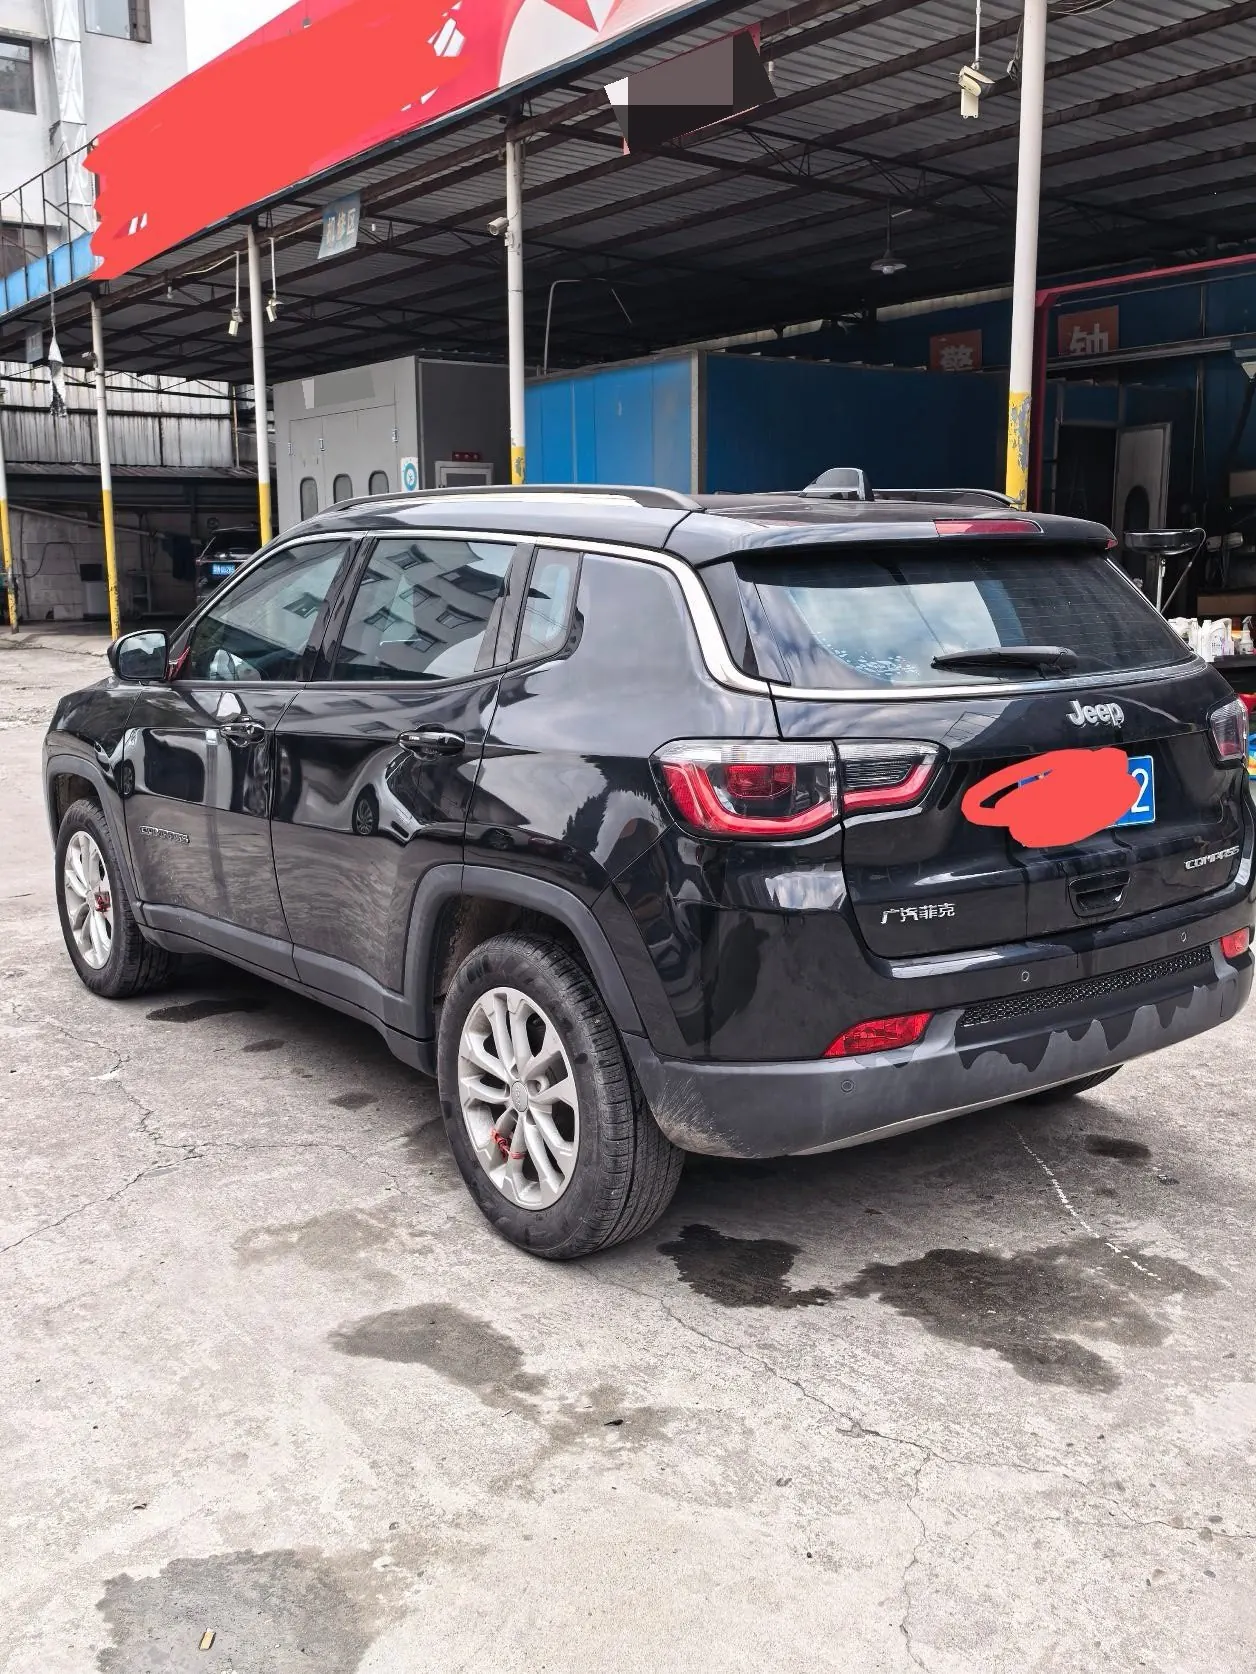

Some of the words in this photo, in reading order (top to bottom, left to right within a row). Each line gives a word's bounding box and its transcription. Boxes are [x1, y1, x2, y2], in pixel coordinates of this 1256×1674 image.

[1066, 699, 1125, 728] Jeep
[1184, 845, 1240, 870] COMPASS
[880, 902, 956, 925] 广汽菲克
